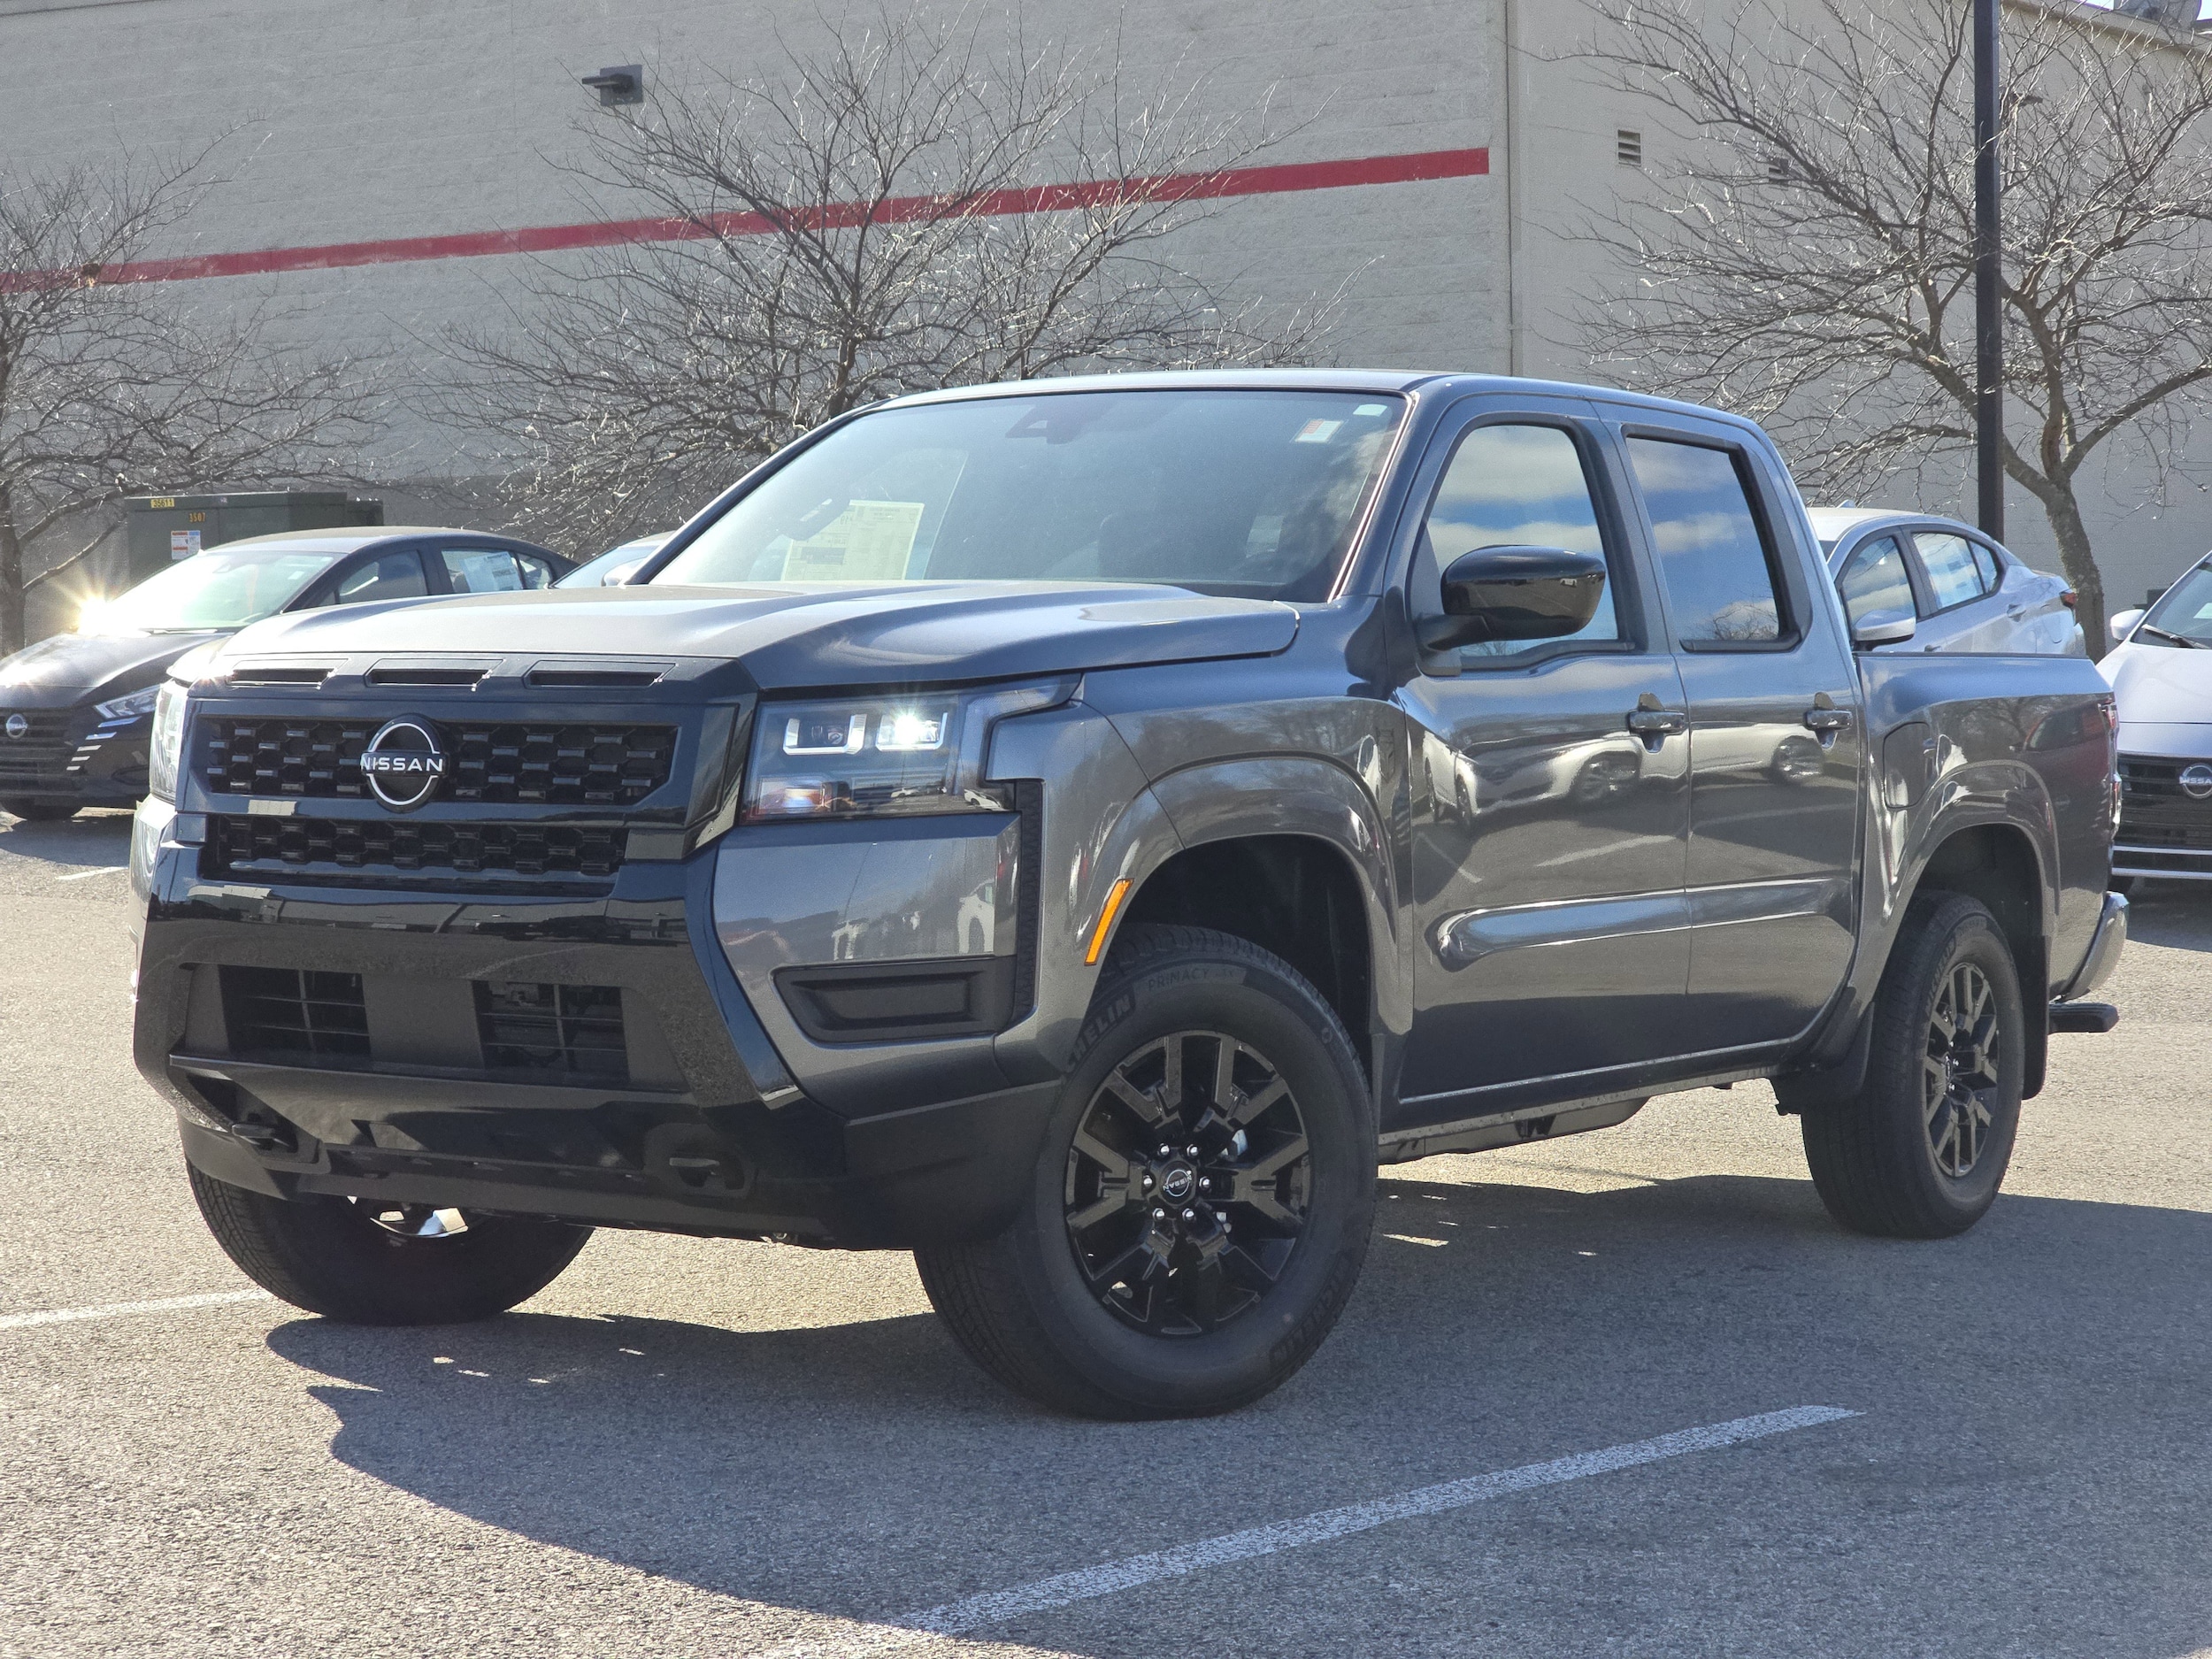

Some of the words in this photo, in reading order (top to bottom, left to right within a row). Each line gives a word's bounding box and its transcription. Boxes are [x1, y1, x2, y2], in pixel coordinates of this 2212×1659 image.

[360, 757, 443, 772] NISSAN
[2179, 775, 2212, 784] NISSA
[1148, 967, 1210, 992] PRIMACY
[1064, 993, 1132, 1074] HELIN
[1163, 1174, 1193, 1191] NISSAN
